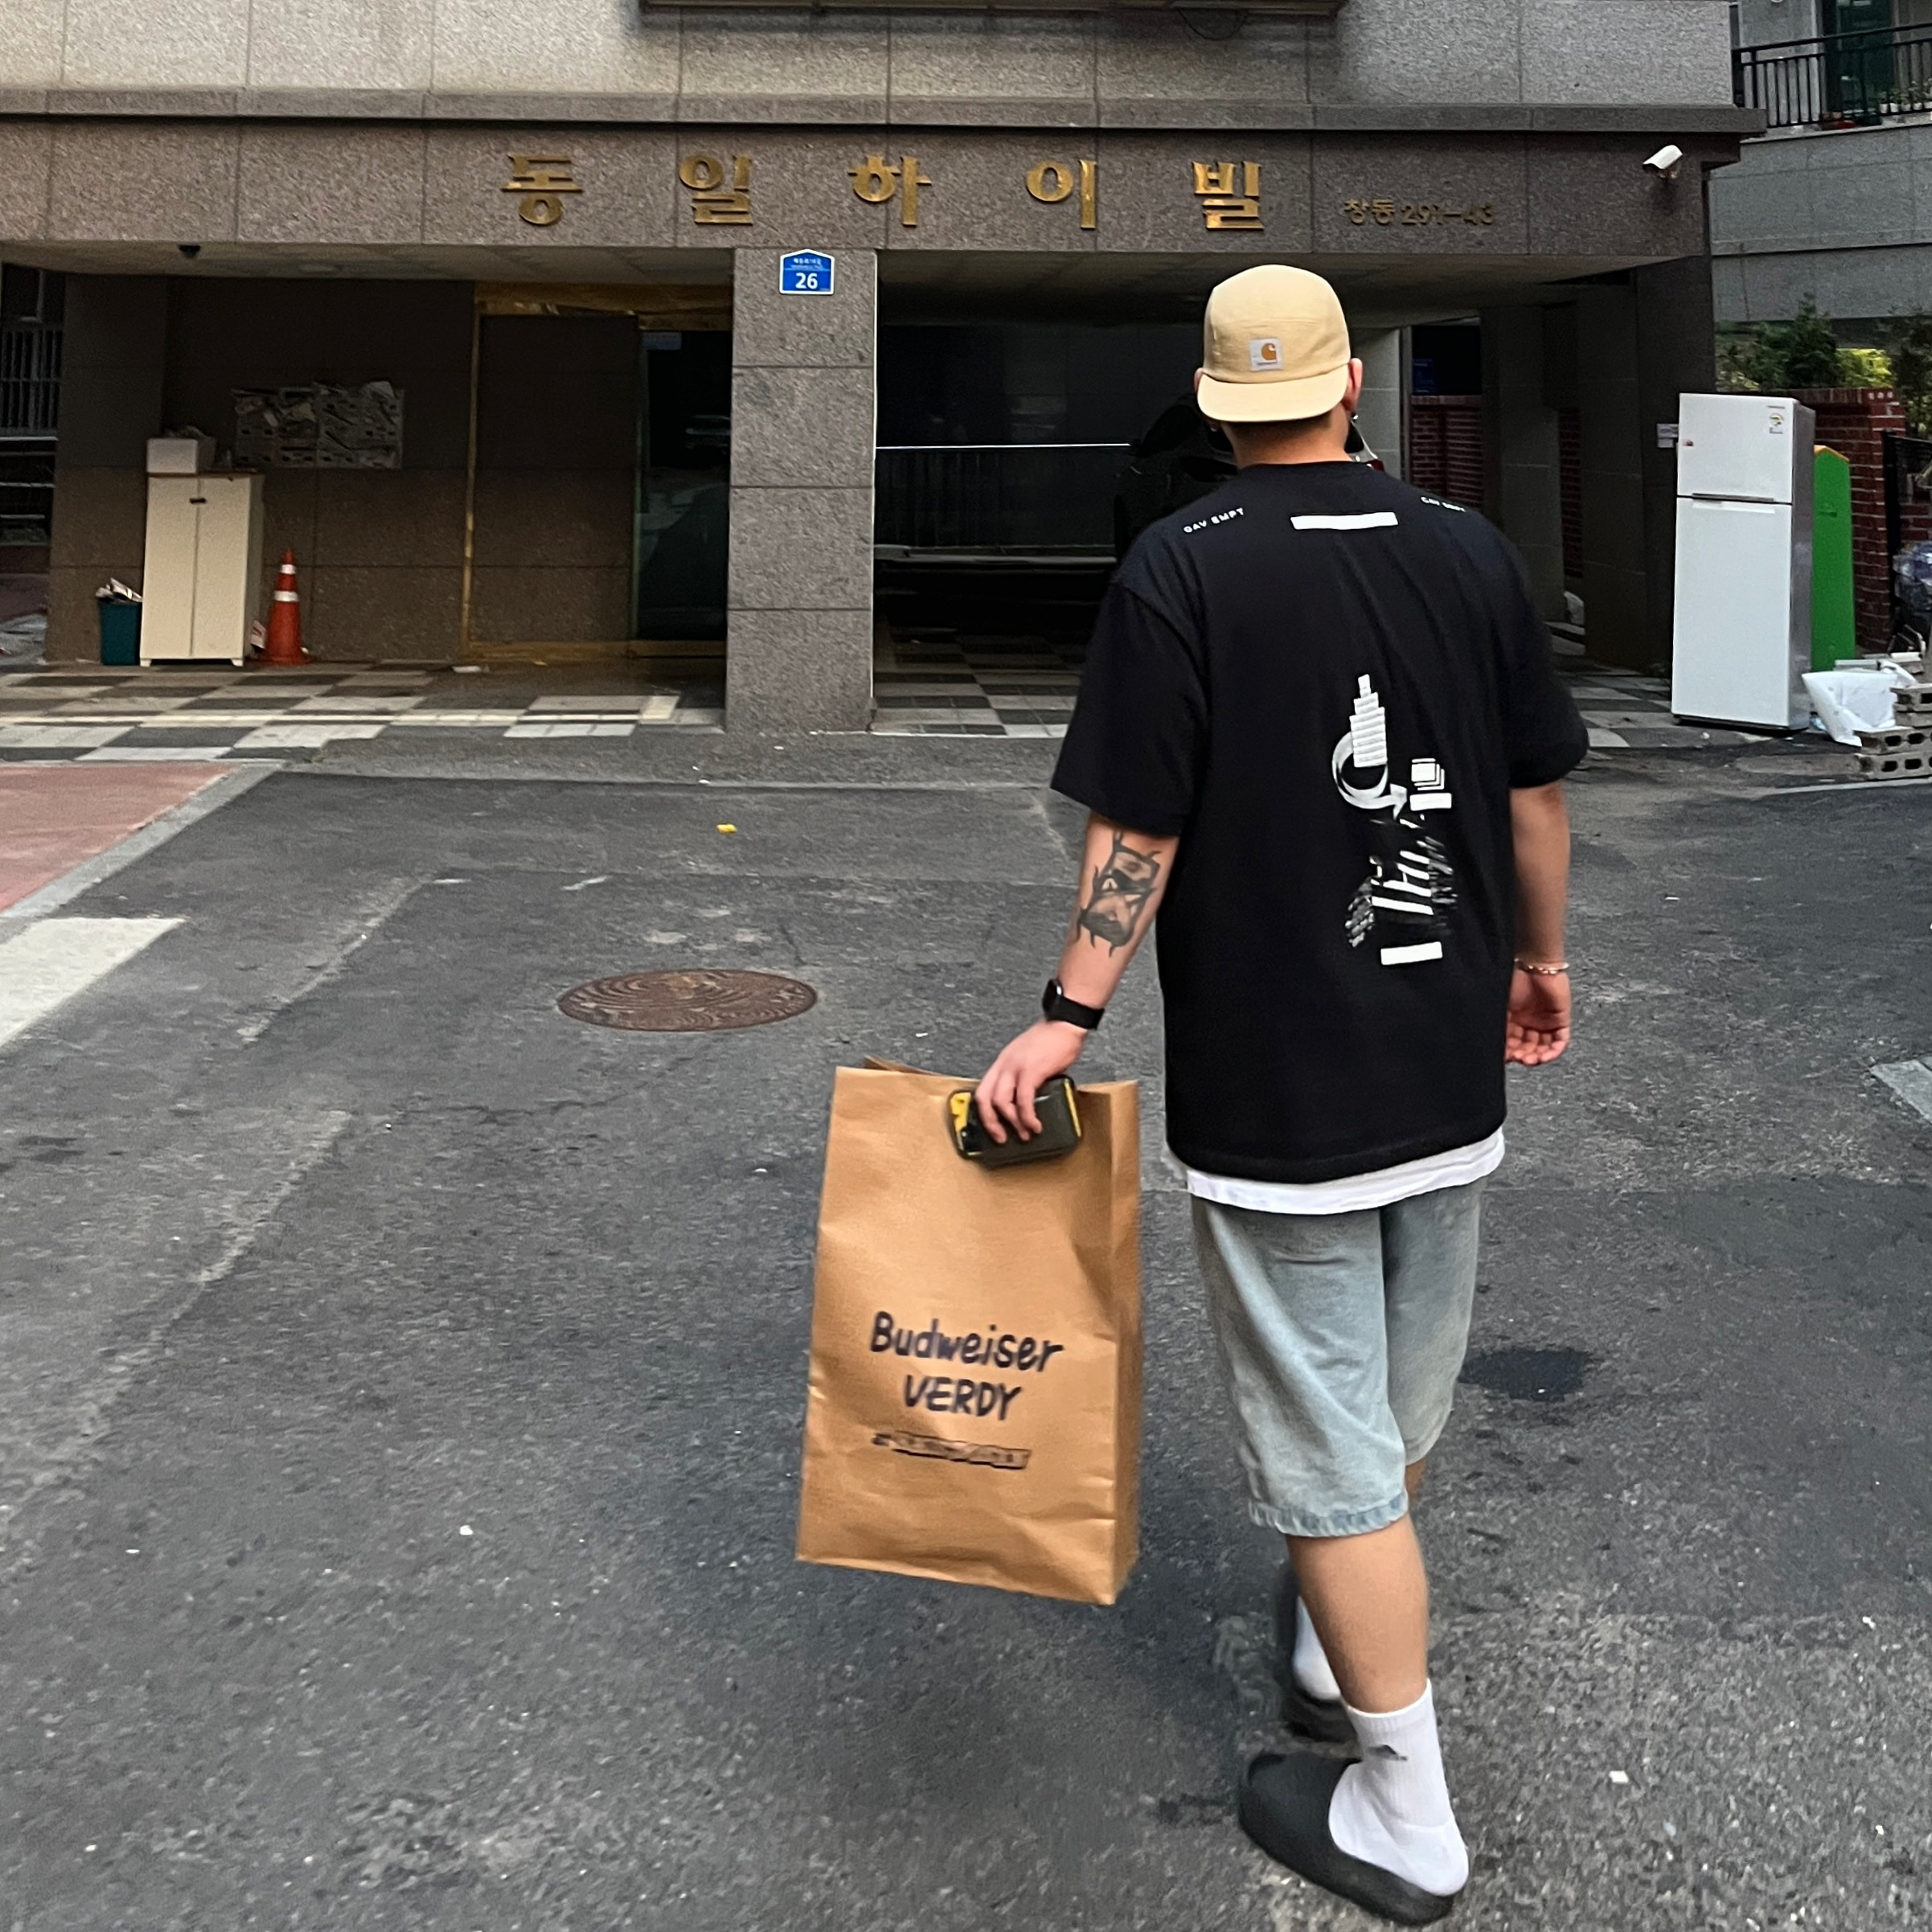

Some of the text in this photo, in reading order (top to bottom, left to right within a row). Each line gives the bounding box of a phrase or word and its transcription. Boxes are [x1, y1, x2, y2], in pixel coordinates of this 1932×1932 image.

[1343, 199, 1395, 226] 창동
[795, 272, 818, 290] 26
[871, 1311, 1064, 1372] Budweiser
[904, 1374, 1022, 1421] VERDY
